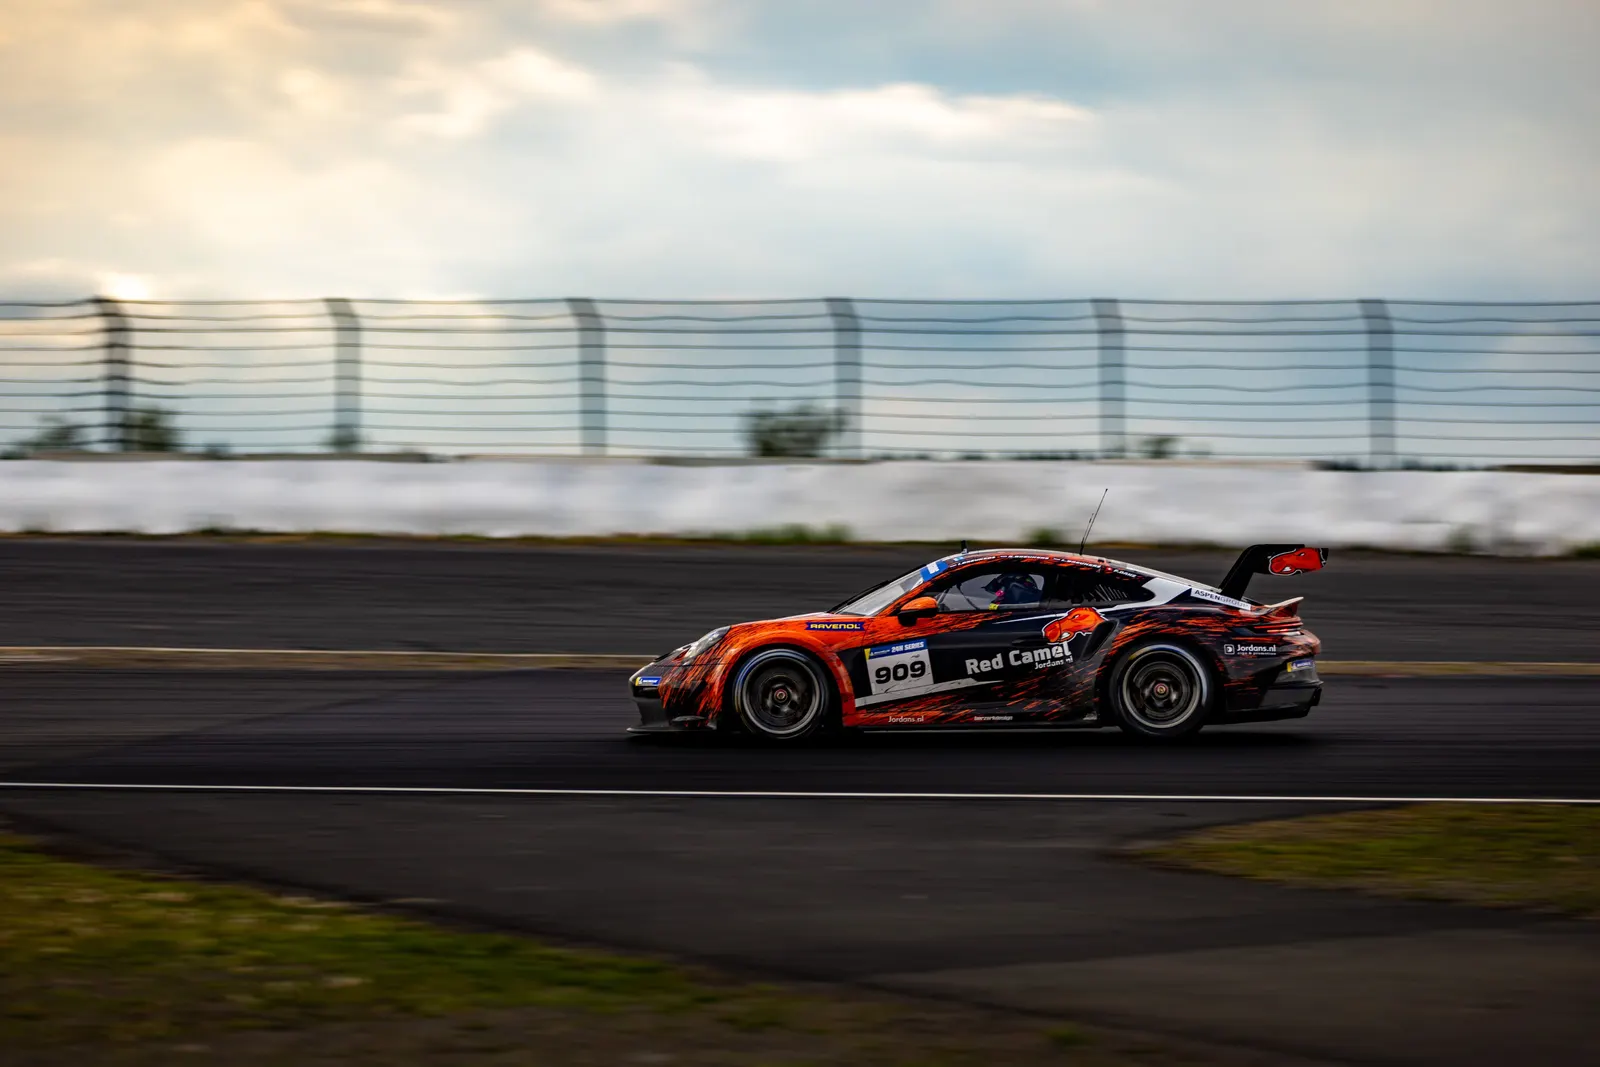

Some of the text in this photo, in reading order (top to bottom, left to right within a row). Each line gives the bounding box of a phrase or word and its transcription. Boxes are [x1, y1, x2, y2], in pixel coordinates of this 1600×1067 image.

[891, 644, 904, 653] 24H
[904, 641, 925, 651] SERIES
[1236, 644, 1277, 652] Jordans.nl
[965, 641, 1072, 675] Red Camel
[875, 660, 926, 684] 909
[888, 715, 924, 723] Jordans.nl
